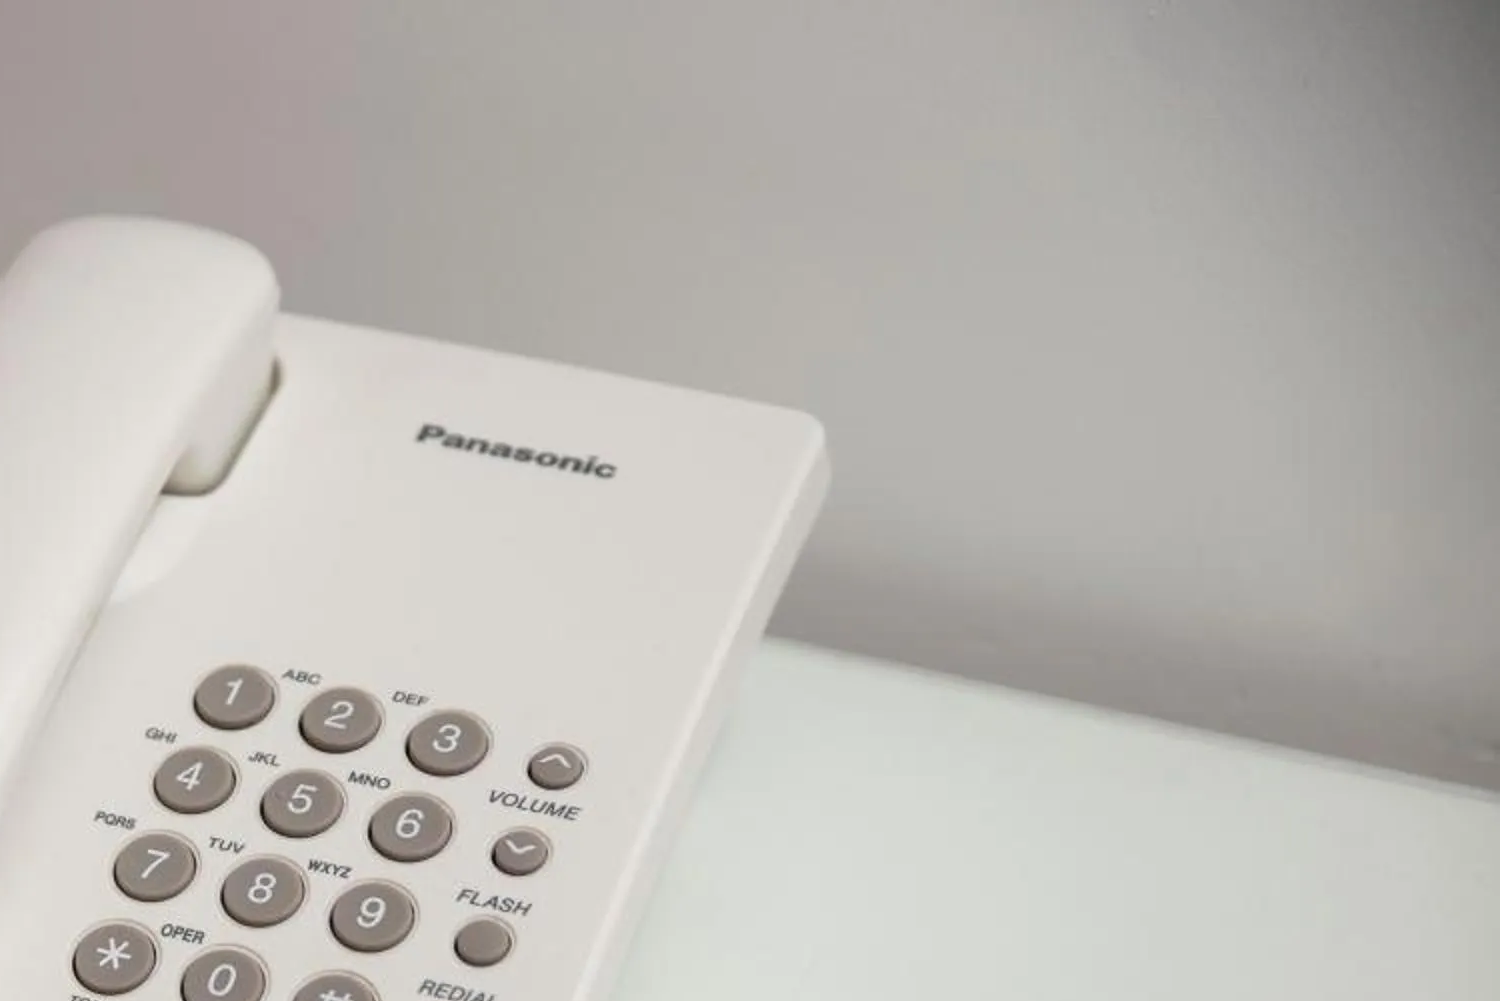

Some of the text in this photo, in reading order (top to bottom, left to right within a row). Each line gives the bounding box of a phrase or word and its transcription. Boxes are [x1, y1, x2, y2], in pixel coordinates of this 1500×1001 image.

[416, 422, 617, 479] Panasonic
[225, 678, 243, 705] 1
[282, 669, 322, 686] ABC
[392, 690, 429, 706] DEF
[324, 701, 354, 729] 2
[145, 727, 177, 744] GHI
[432, 724, 461, 753] 3
[248, 751, 280, 767] JKL
[175, 762, 204, 790] 4
[348, 771, 391, 790] MNO
[287, 784, 318, 813] 5
[488, 789, 583, 821] VOLUME
[94, 810, 136, 830] PQRS
[395, 809, 424, 838] 6
[208, 836, 245, 853] TUV
[141, 849, 171, 879] 7
[308, 858, 351, 879] WXYZ
[247, 873, 277, 904] 8
[456, 888, 533, 916] FLASH
[356, 896, 386, 928] 9
[161, 924, 205, 944] OPER
[207, 963, 236, 996] 0
